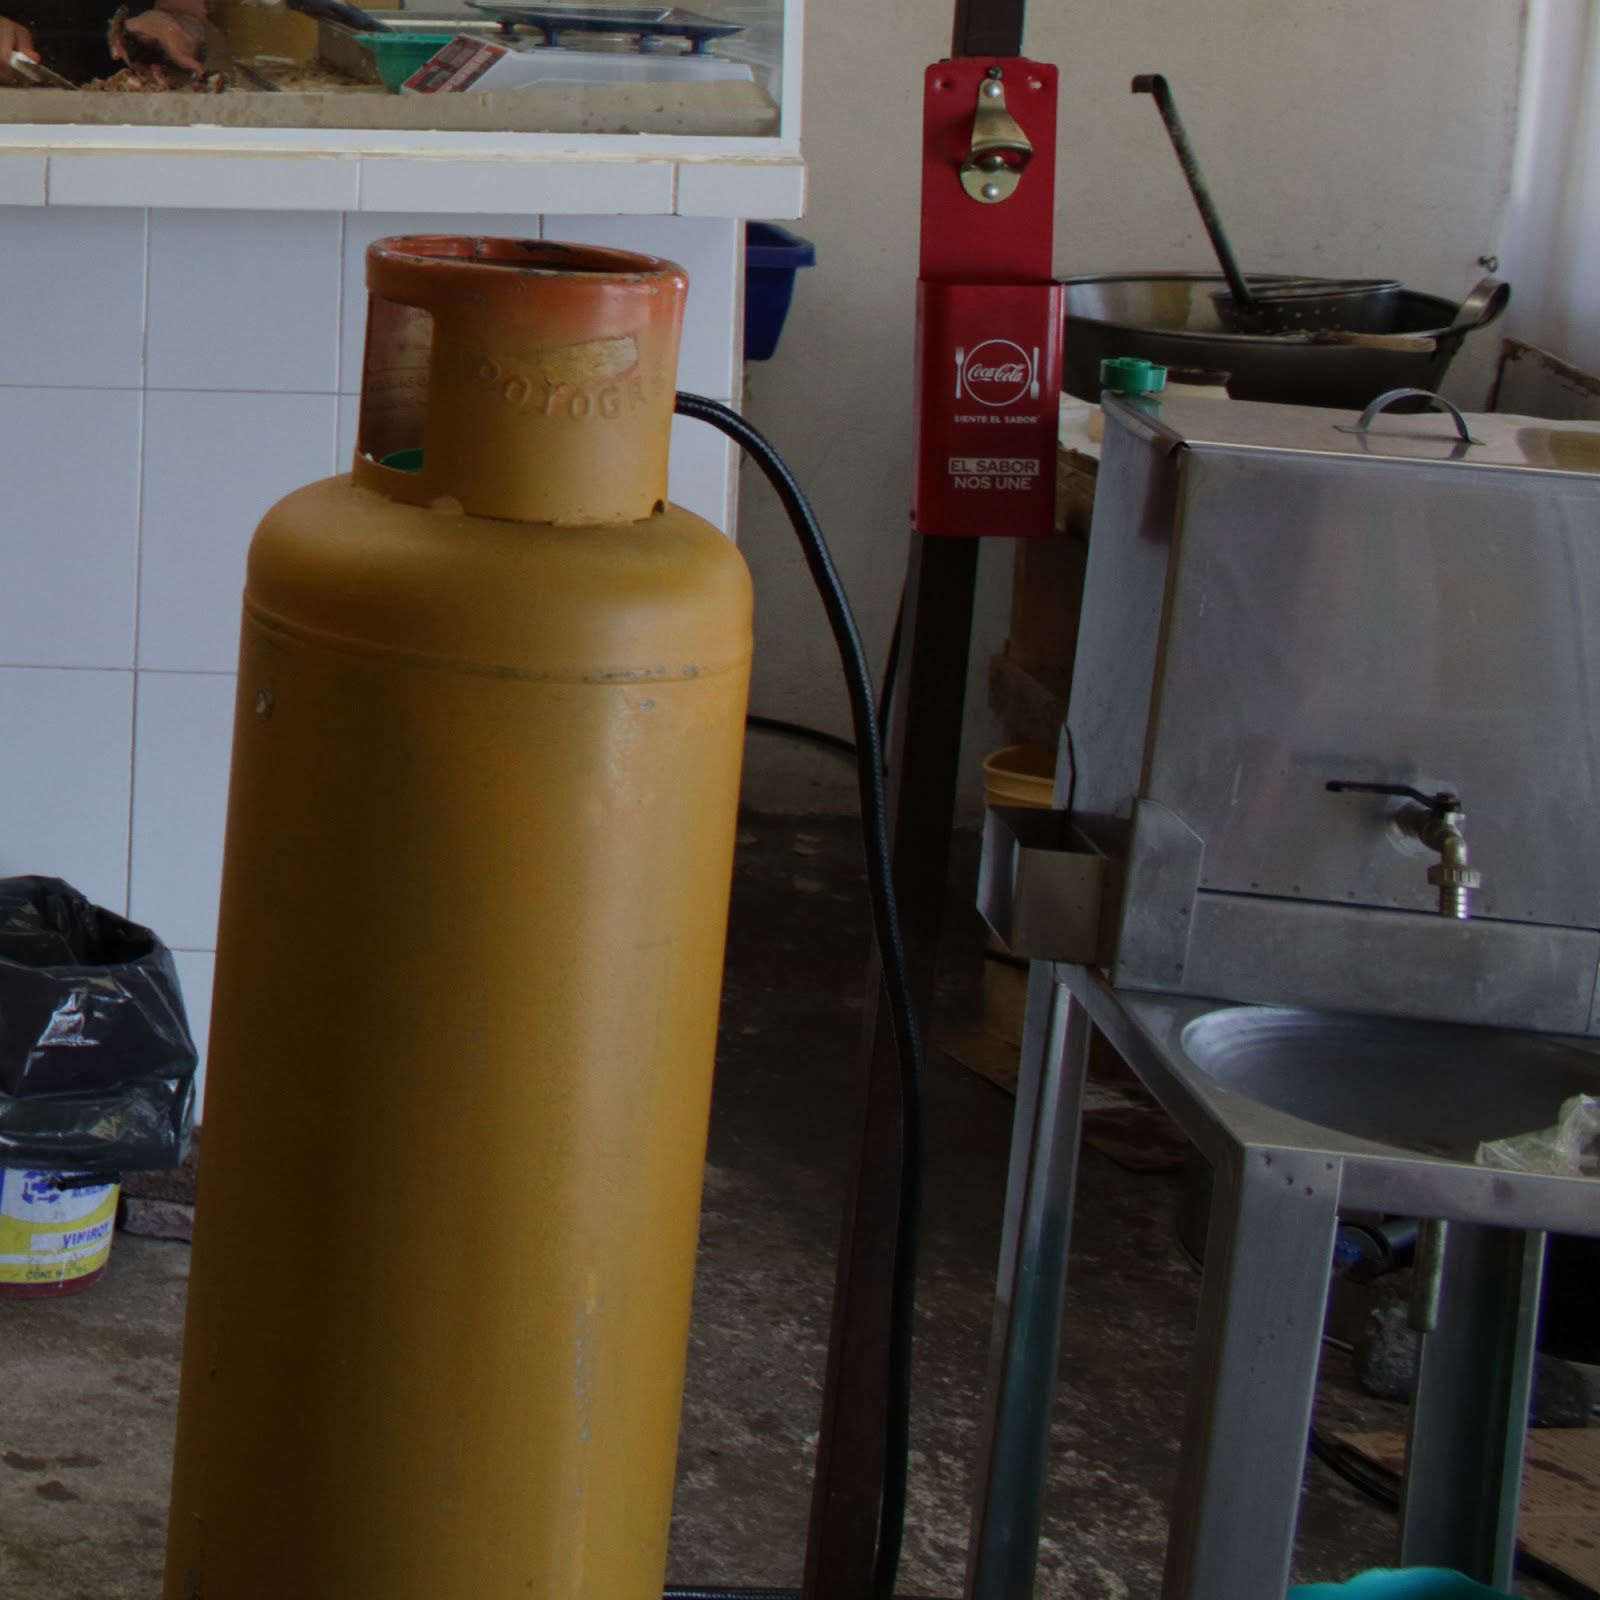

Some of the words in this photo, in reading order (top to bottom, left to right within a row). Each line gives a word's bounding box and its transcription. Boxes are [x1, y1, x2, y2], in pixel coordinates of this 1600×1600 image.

[967, 363, 1026, 383] Coca-Cola
[954, 415, 987, 424] SIENTE
[989, 415, 1001, 424] EL
[1004, 415, 1037, 424] SABOR
[951, 460, 972, 473] EL
[976, 459, 1036, 474] SABOR
[954, 476, 992, 490] NOS
[995, 477, 1033, 490] UNE
